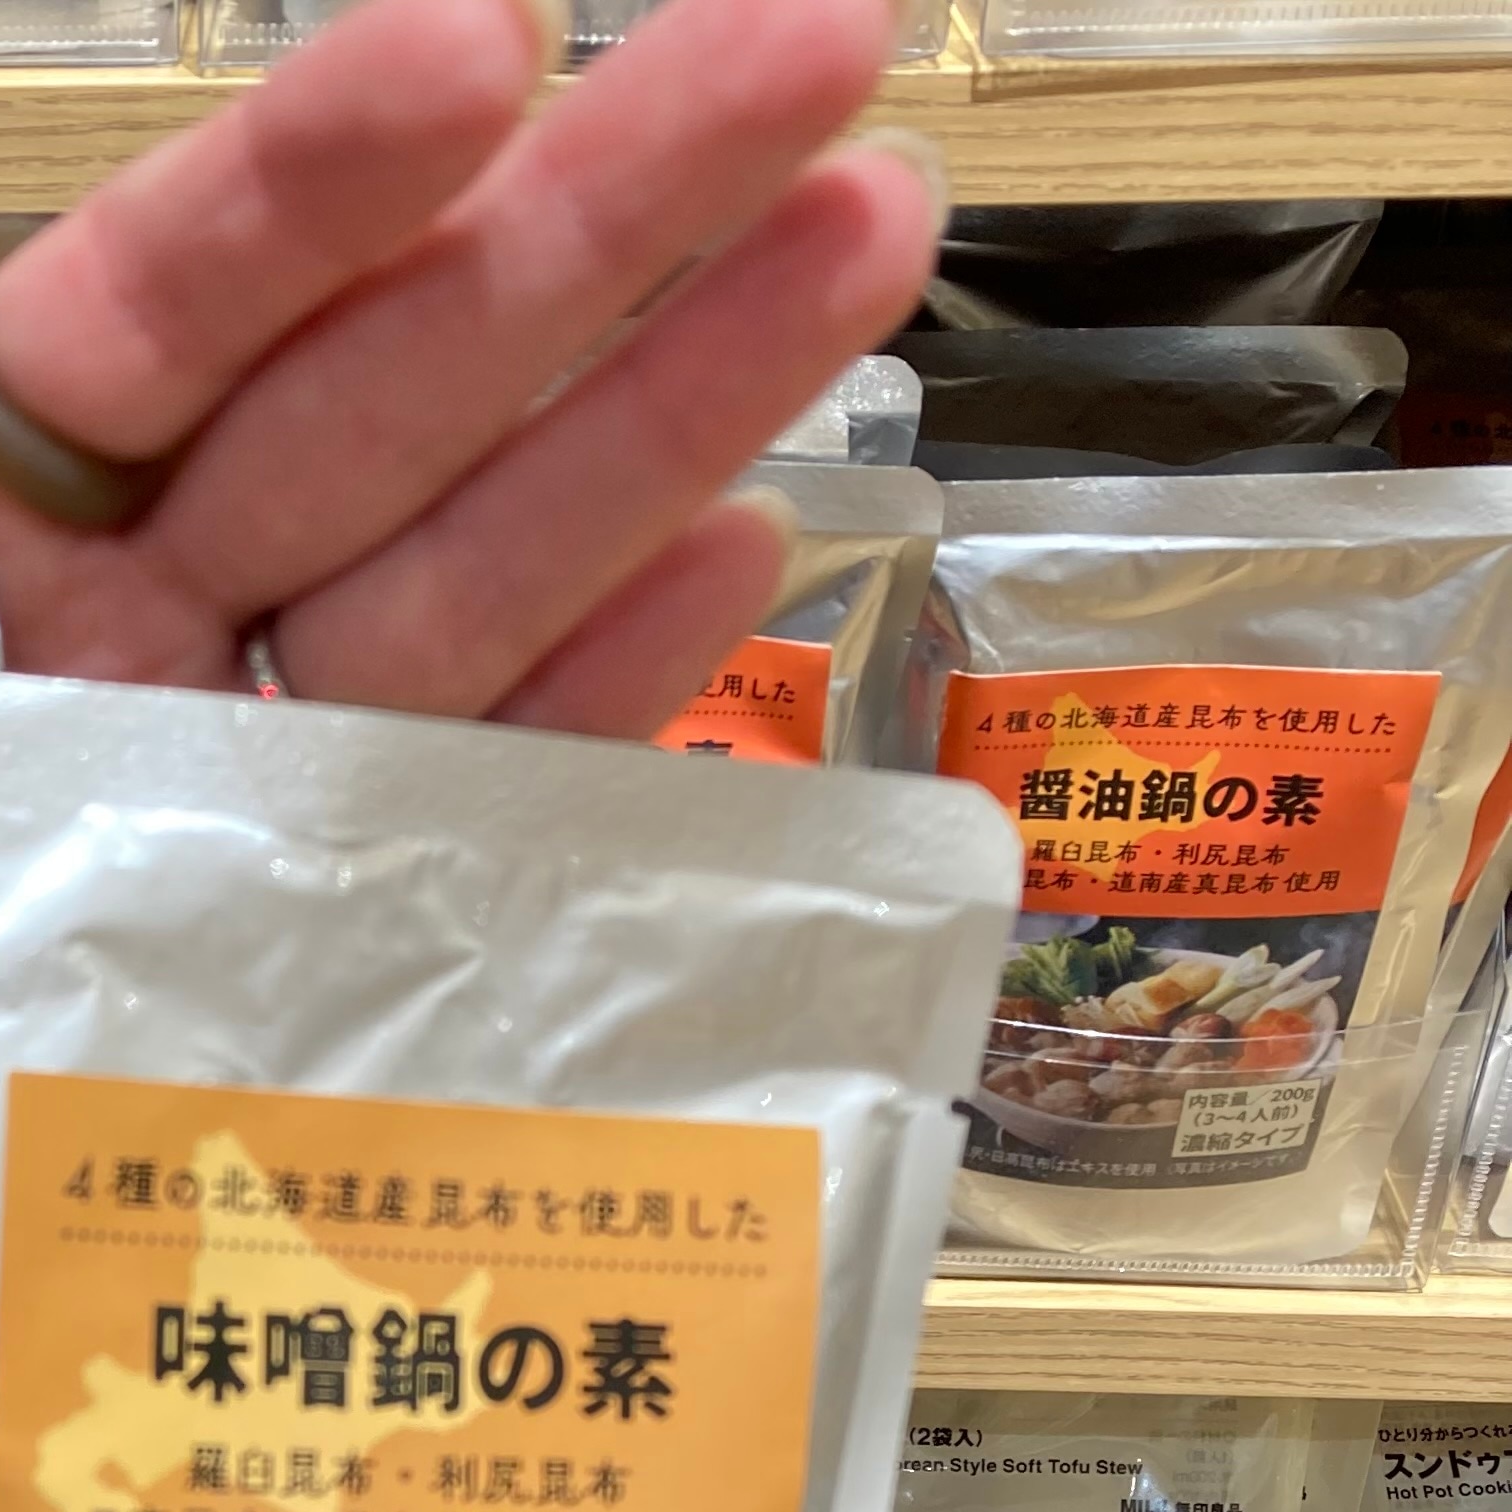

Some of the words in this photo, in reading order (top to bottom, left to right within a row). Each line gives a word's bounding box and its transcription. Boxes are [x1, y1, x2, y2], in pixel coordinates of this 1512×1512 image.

[700, 674, 796, 704] 用した
[976, 702, 1397, 736] 4種の北海道産昆布を使用した
[1018, 767, 1325, 827] 醤油鍋の素
[1030, 839, 1290, 867] 羅臼昆布・利尻昆布
[1180, 1122, 1306, 1153] 濃縮タイプ
[60, 1154, 770, 1245] 4種の北海道産昆布を使用した
[151, 1299, 676, 1422] 味噌鍋の素
[950, 1458, 997, 1475] Style
[1003, 1458, 1042, 1474] Soft
[1048, 1459, 1090, 1475] Tofu
[1096, 1460, 1143, 1475] Stew
[1386, 1486, 1418, 1500] Hot
[1423, 1484, 1454, 1498] Pot
